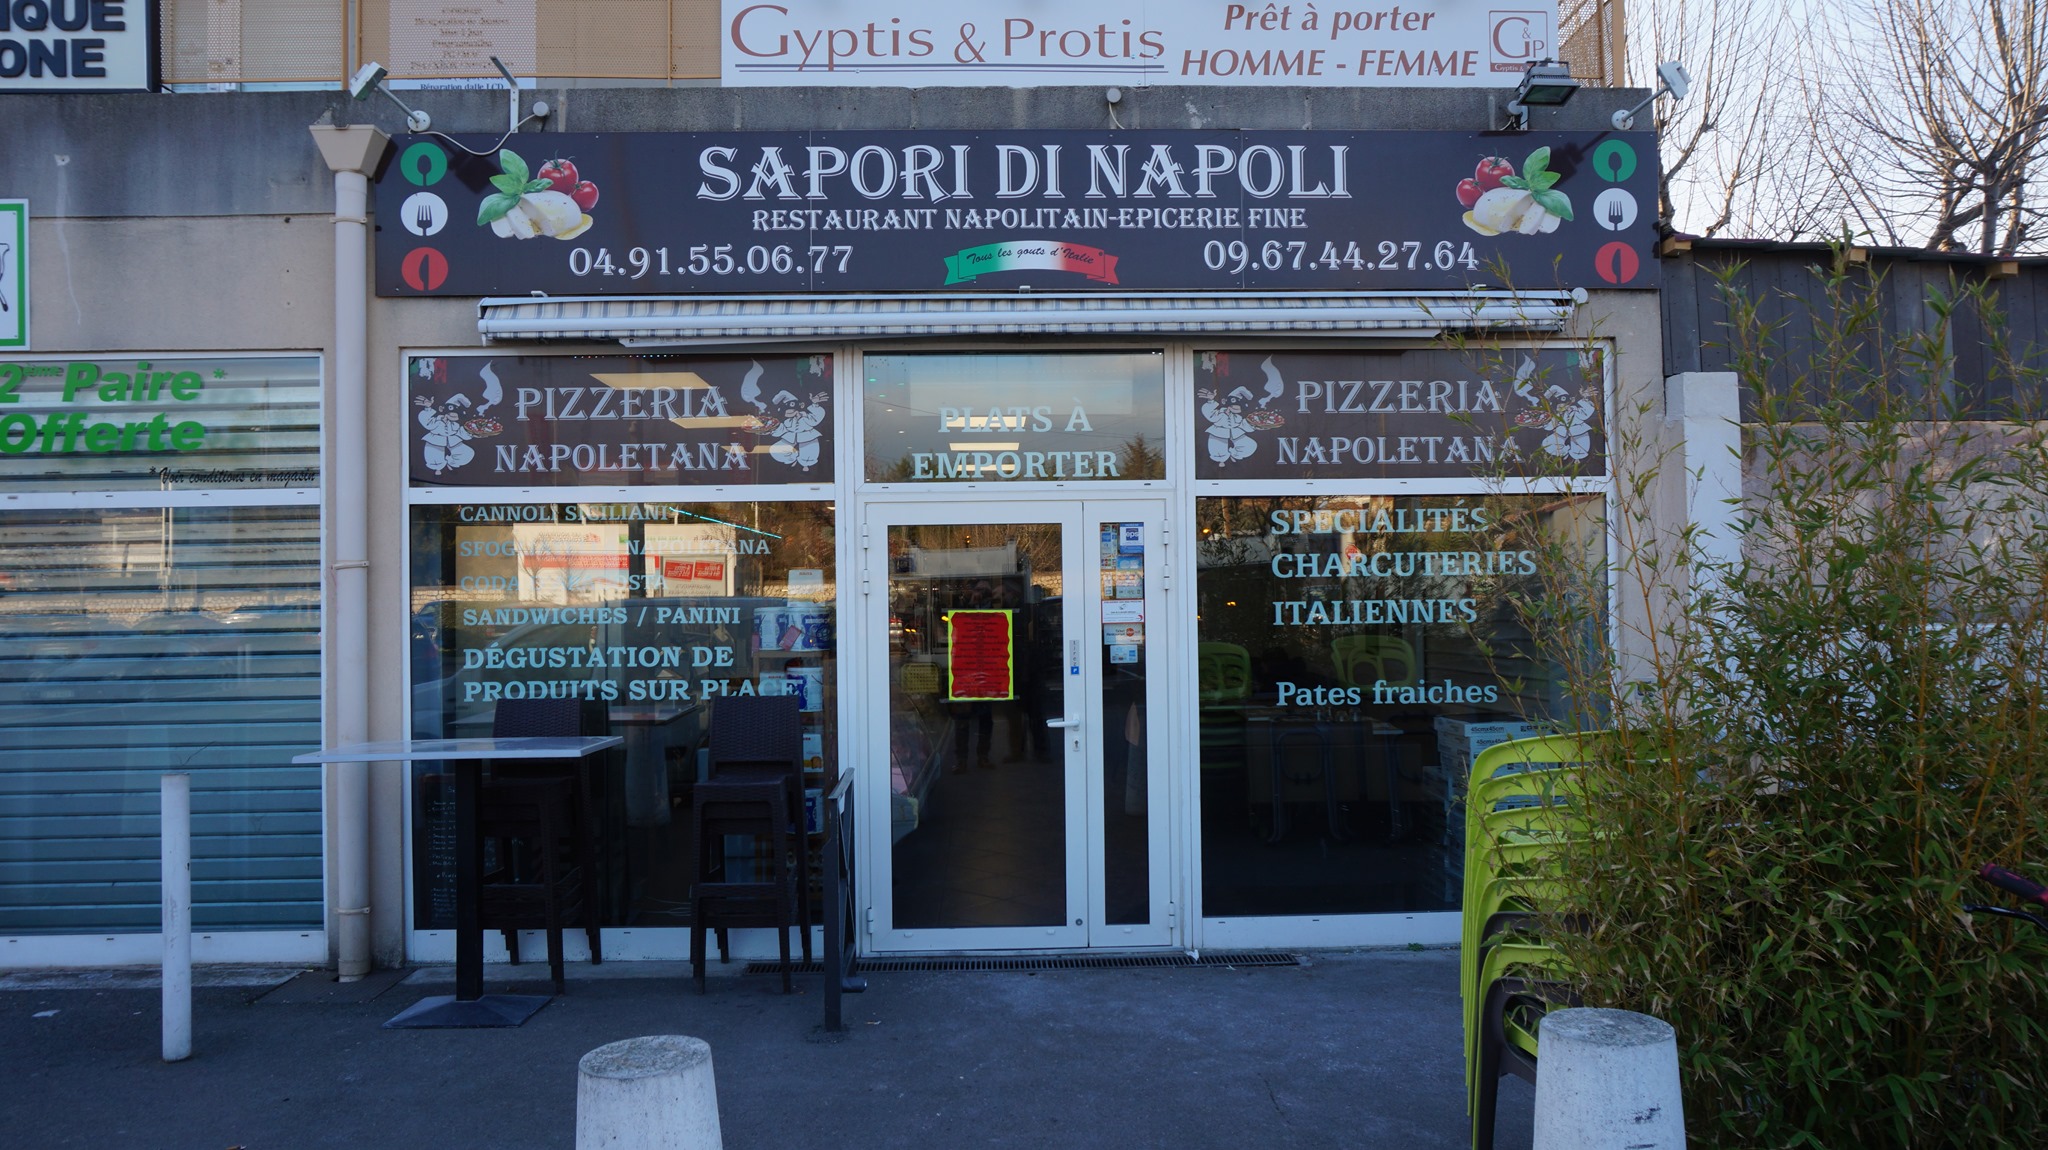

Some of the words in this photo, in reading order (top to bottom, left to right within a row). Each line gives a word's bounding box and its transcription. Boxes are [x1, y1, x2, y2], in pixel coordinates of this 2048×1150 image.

[0, 0, 126, 32] IQUE
[1224, 3, 1291, 31] Prêt
[1301, 2, 1319, 31] à
[1331, 8, 1435, 40] porter
[731, 4, 934, 71] Gyptis
[954, 22, 986, 64] &
[1004, 18, 1165, 58] Protis
[1493, 17, 1530, 58] G
[1533, 40, 1545, 58] P
[0, 38, 106, 78] ONE
[1181, 49, 1325, 76] HOMME
[1358, 50, 1479, 77] FEMME
[696, 144, 973, 204] SAPORI
[995, 144, 1066, 200] DI
[1085, 144, 1353, 200] NAPOLI
[752, 209, 937, 232] RESTAURANT
[944, 207, 1242, 231] NAPOLITAIN-EPICERIE
[1248, 207, 1307, 230] FINE
[569, 244, 854, 279] 04.91.55.06.77
[966, 252, 993, 265] Tous
[997, 247, 1013, 257] les
[1017, 247, 1046, 260] gouts
[1050, 247, 1095, 265] d'Italie
[1204, 240, 1480, 273] 09.67.44.27.64
[62, 361, 204, 402] Paire
[516, 386, 731, 421] PIZZERIA
[1297, 380, 1504, 414] PIZZERIA
[938, 406, 1053, 433] PLATS
[1065, 397, 1093, 432] À
[0, 412, 205, 453] Offerte
[494, 442, 751, 473] NAPOLETANA
[912, 451, 1120, 479] EMPORTER
[1276, 436, 1526, 465] NAPOLETANA
[189, 468, 245, 484] conditions
[250, 472, 262, 483] en
[267, 468, 316, 487] magasin
[460, 505, 557, 522] CANNOLI
[565, 505, 668, 521] SICILIANI
[1270, 499, 1490, 535] SPÉCIALITÉS
[625, 539, 771, 556] NAPOLETANA
[1271, 550, 1537, 578] CHARCUTERIES
[460, 575, 520, 592] CODA
[463, 608, 628, 626] SANDWICHES
[637, 607, 647, 628] /
[656, 607, 741, 625] PANINI
[1272, 598, 1478, 626] ITALIENNES
[463, 642, 682, 670] DÉGUSTATION
[692, 647, 734, 668] DE
[463, 680, 619, 702] PRODUITS
[629, 680, 690, 701] SUR
[1276, 682, 1362, 707] Pates
[1372, 679, 1498, 705] fraiches
